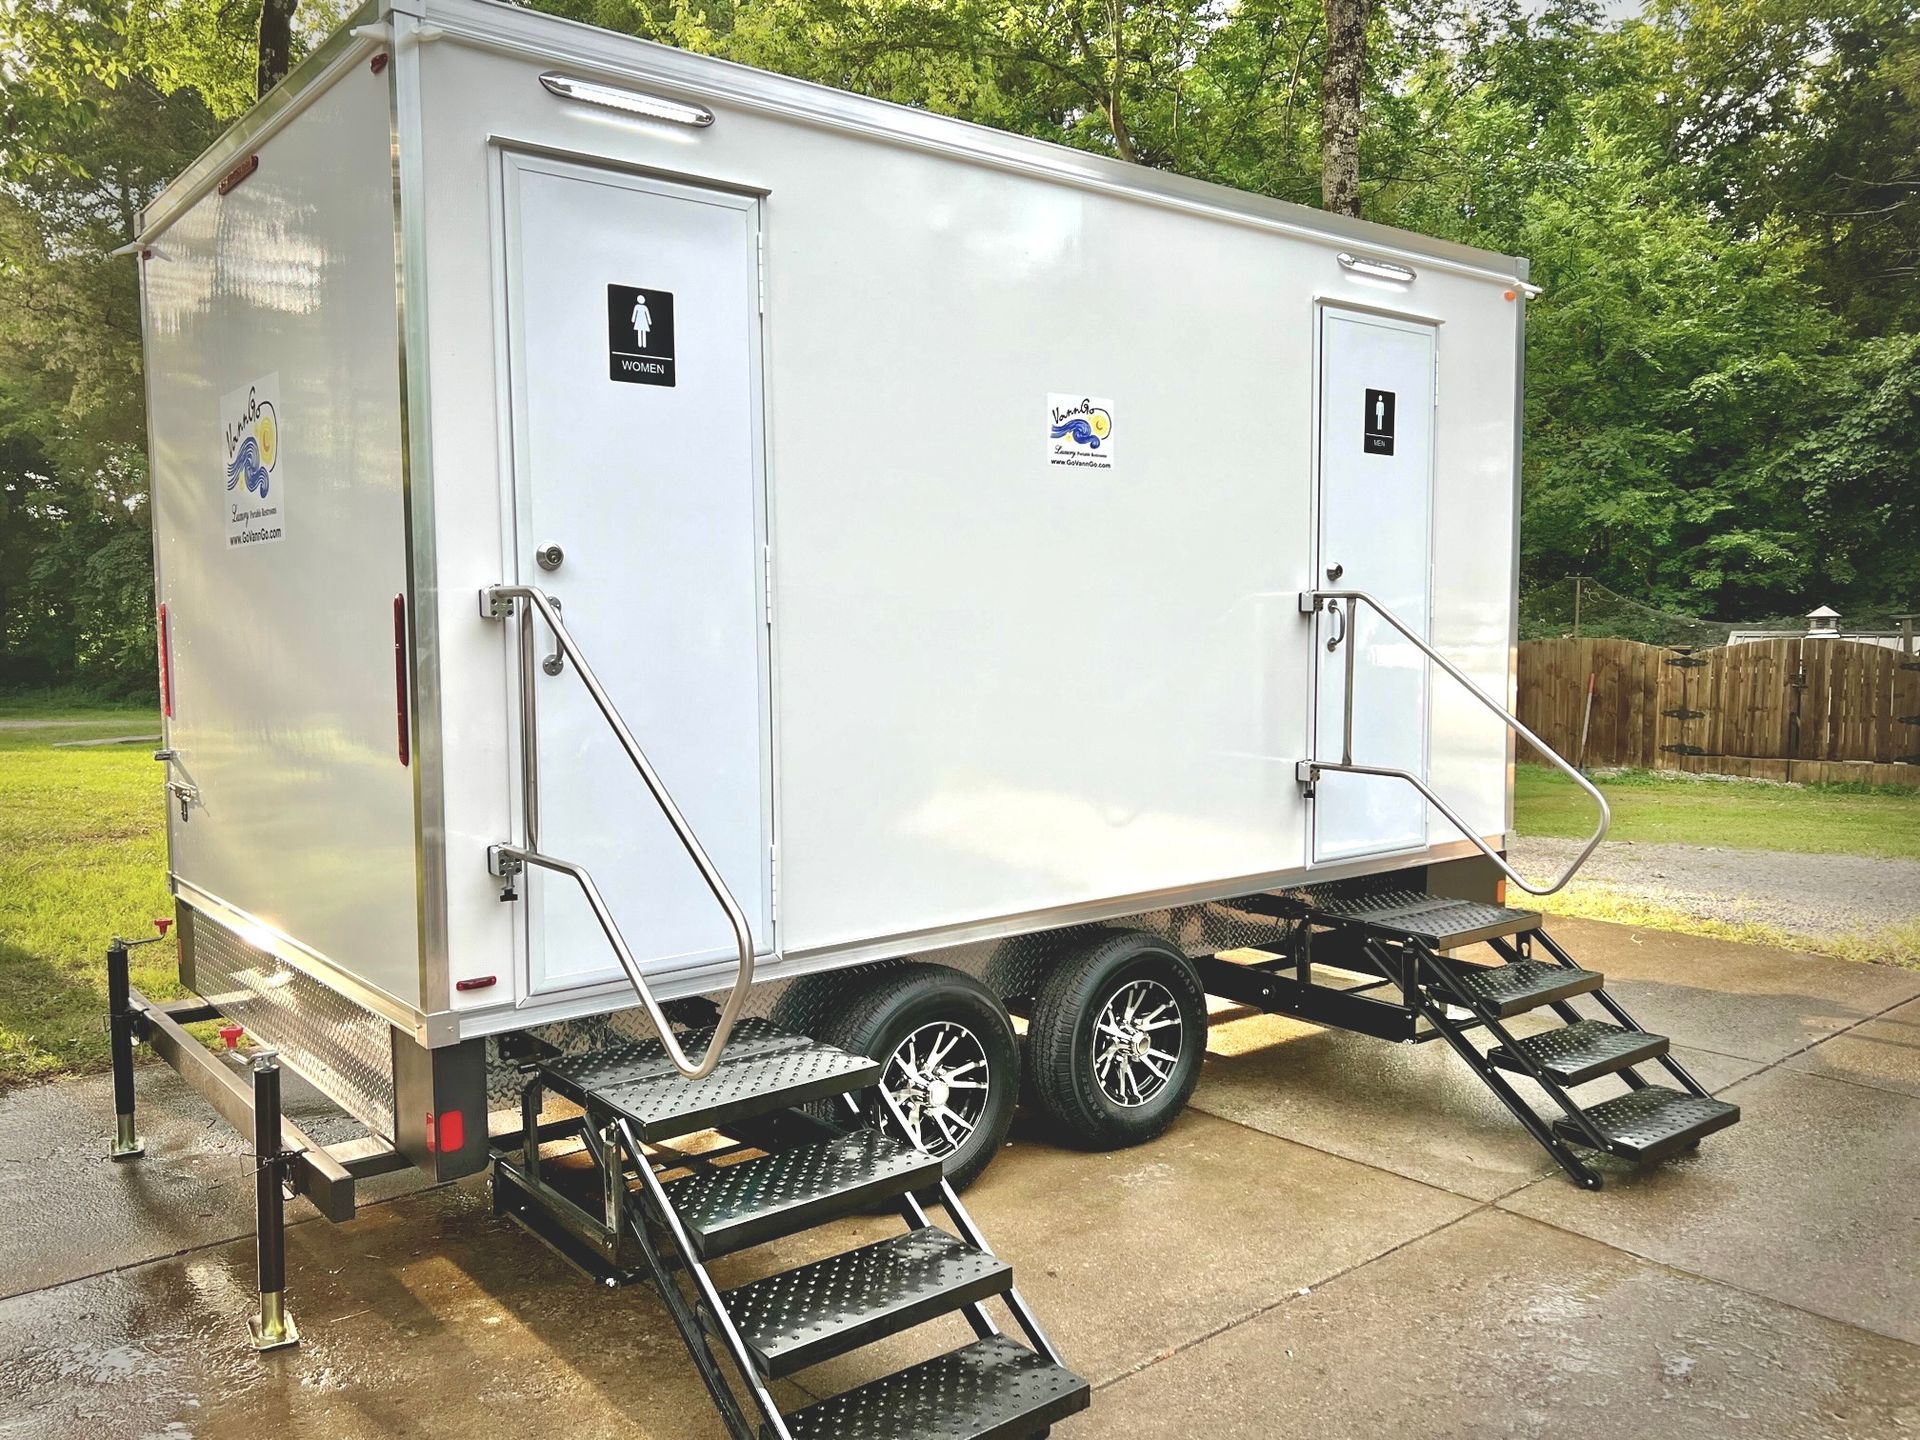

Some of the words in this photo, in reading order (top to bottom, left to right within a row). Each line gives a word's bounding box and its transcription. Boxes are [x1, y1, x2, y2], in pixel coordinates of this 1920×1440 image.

[621, 360, 665, 374] WOMEN
[1051, 459, 1111, 468] www.GoVannGo.com
[230, 528, 281, 545] www.GoVannGo.com
